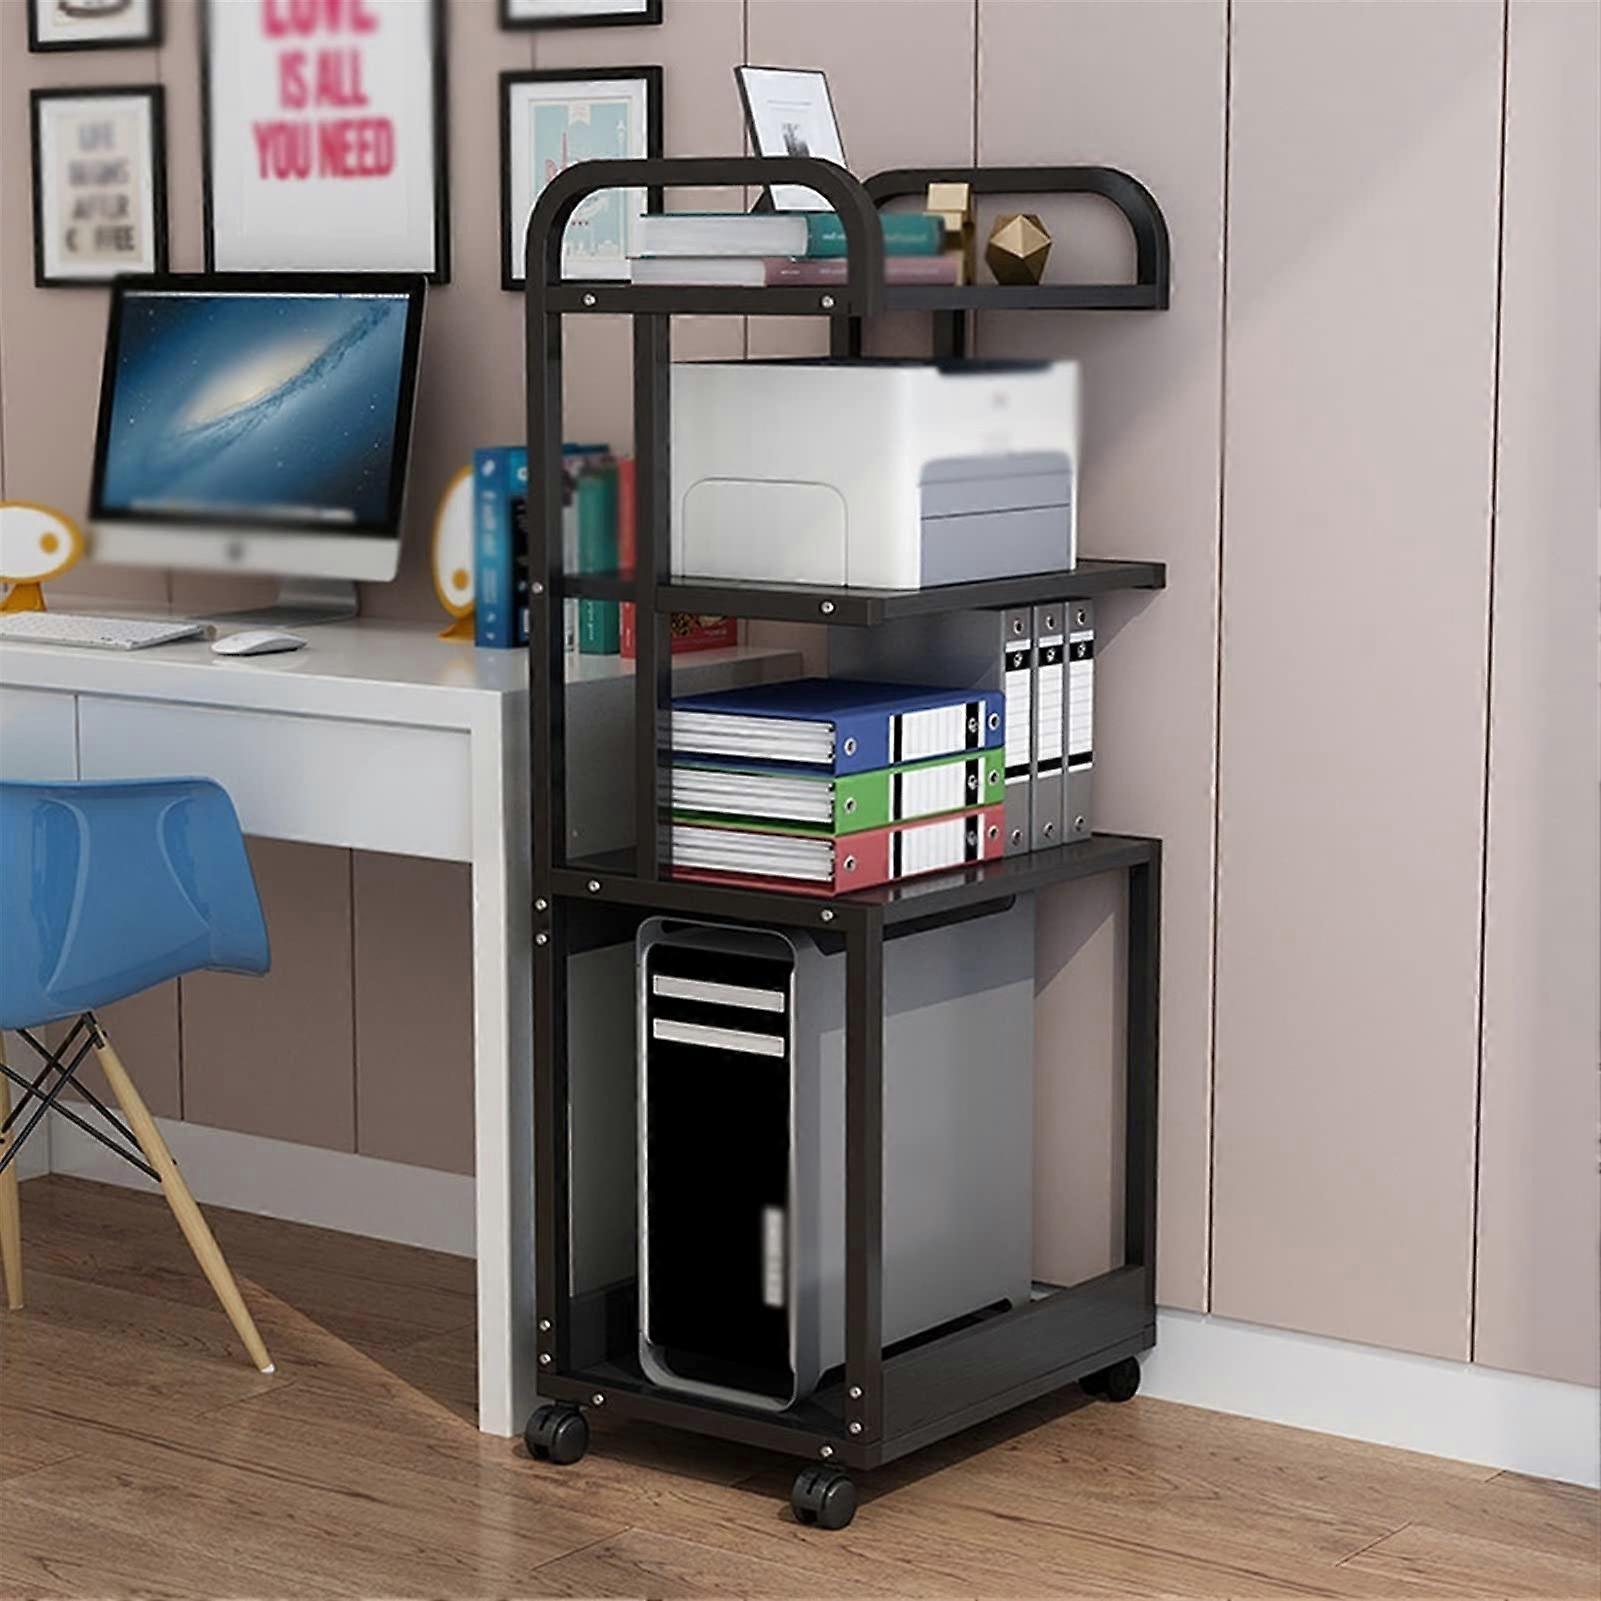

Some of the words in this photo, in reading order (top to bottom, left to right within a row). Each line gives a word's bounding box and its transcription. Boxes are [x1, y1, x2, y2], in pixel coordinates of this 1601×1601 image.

[279, 51, 308, 108] IS
[315, 50, 370, 107] ALL
[253, 120, 311, 179] YOU
[319, 117, 395, 178] NEED
